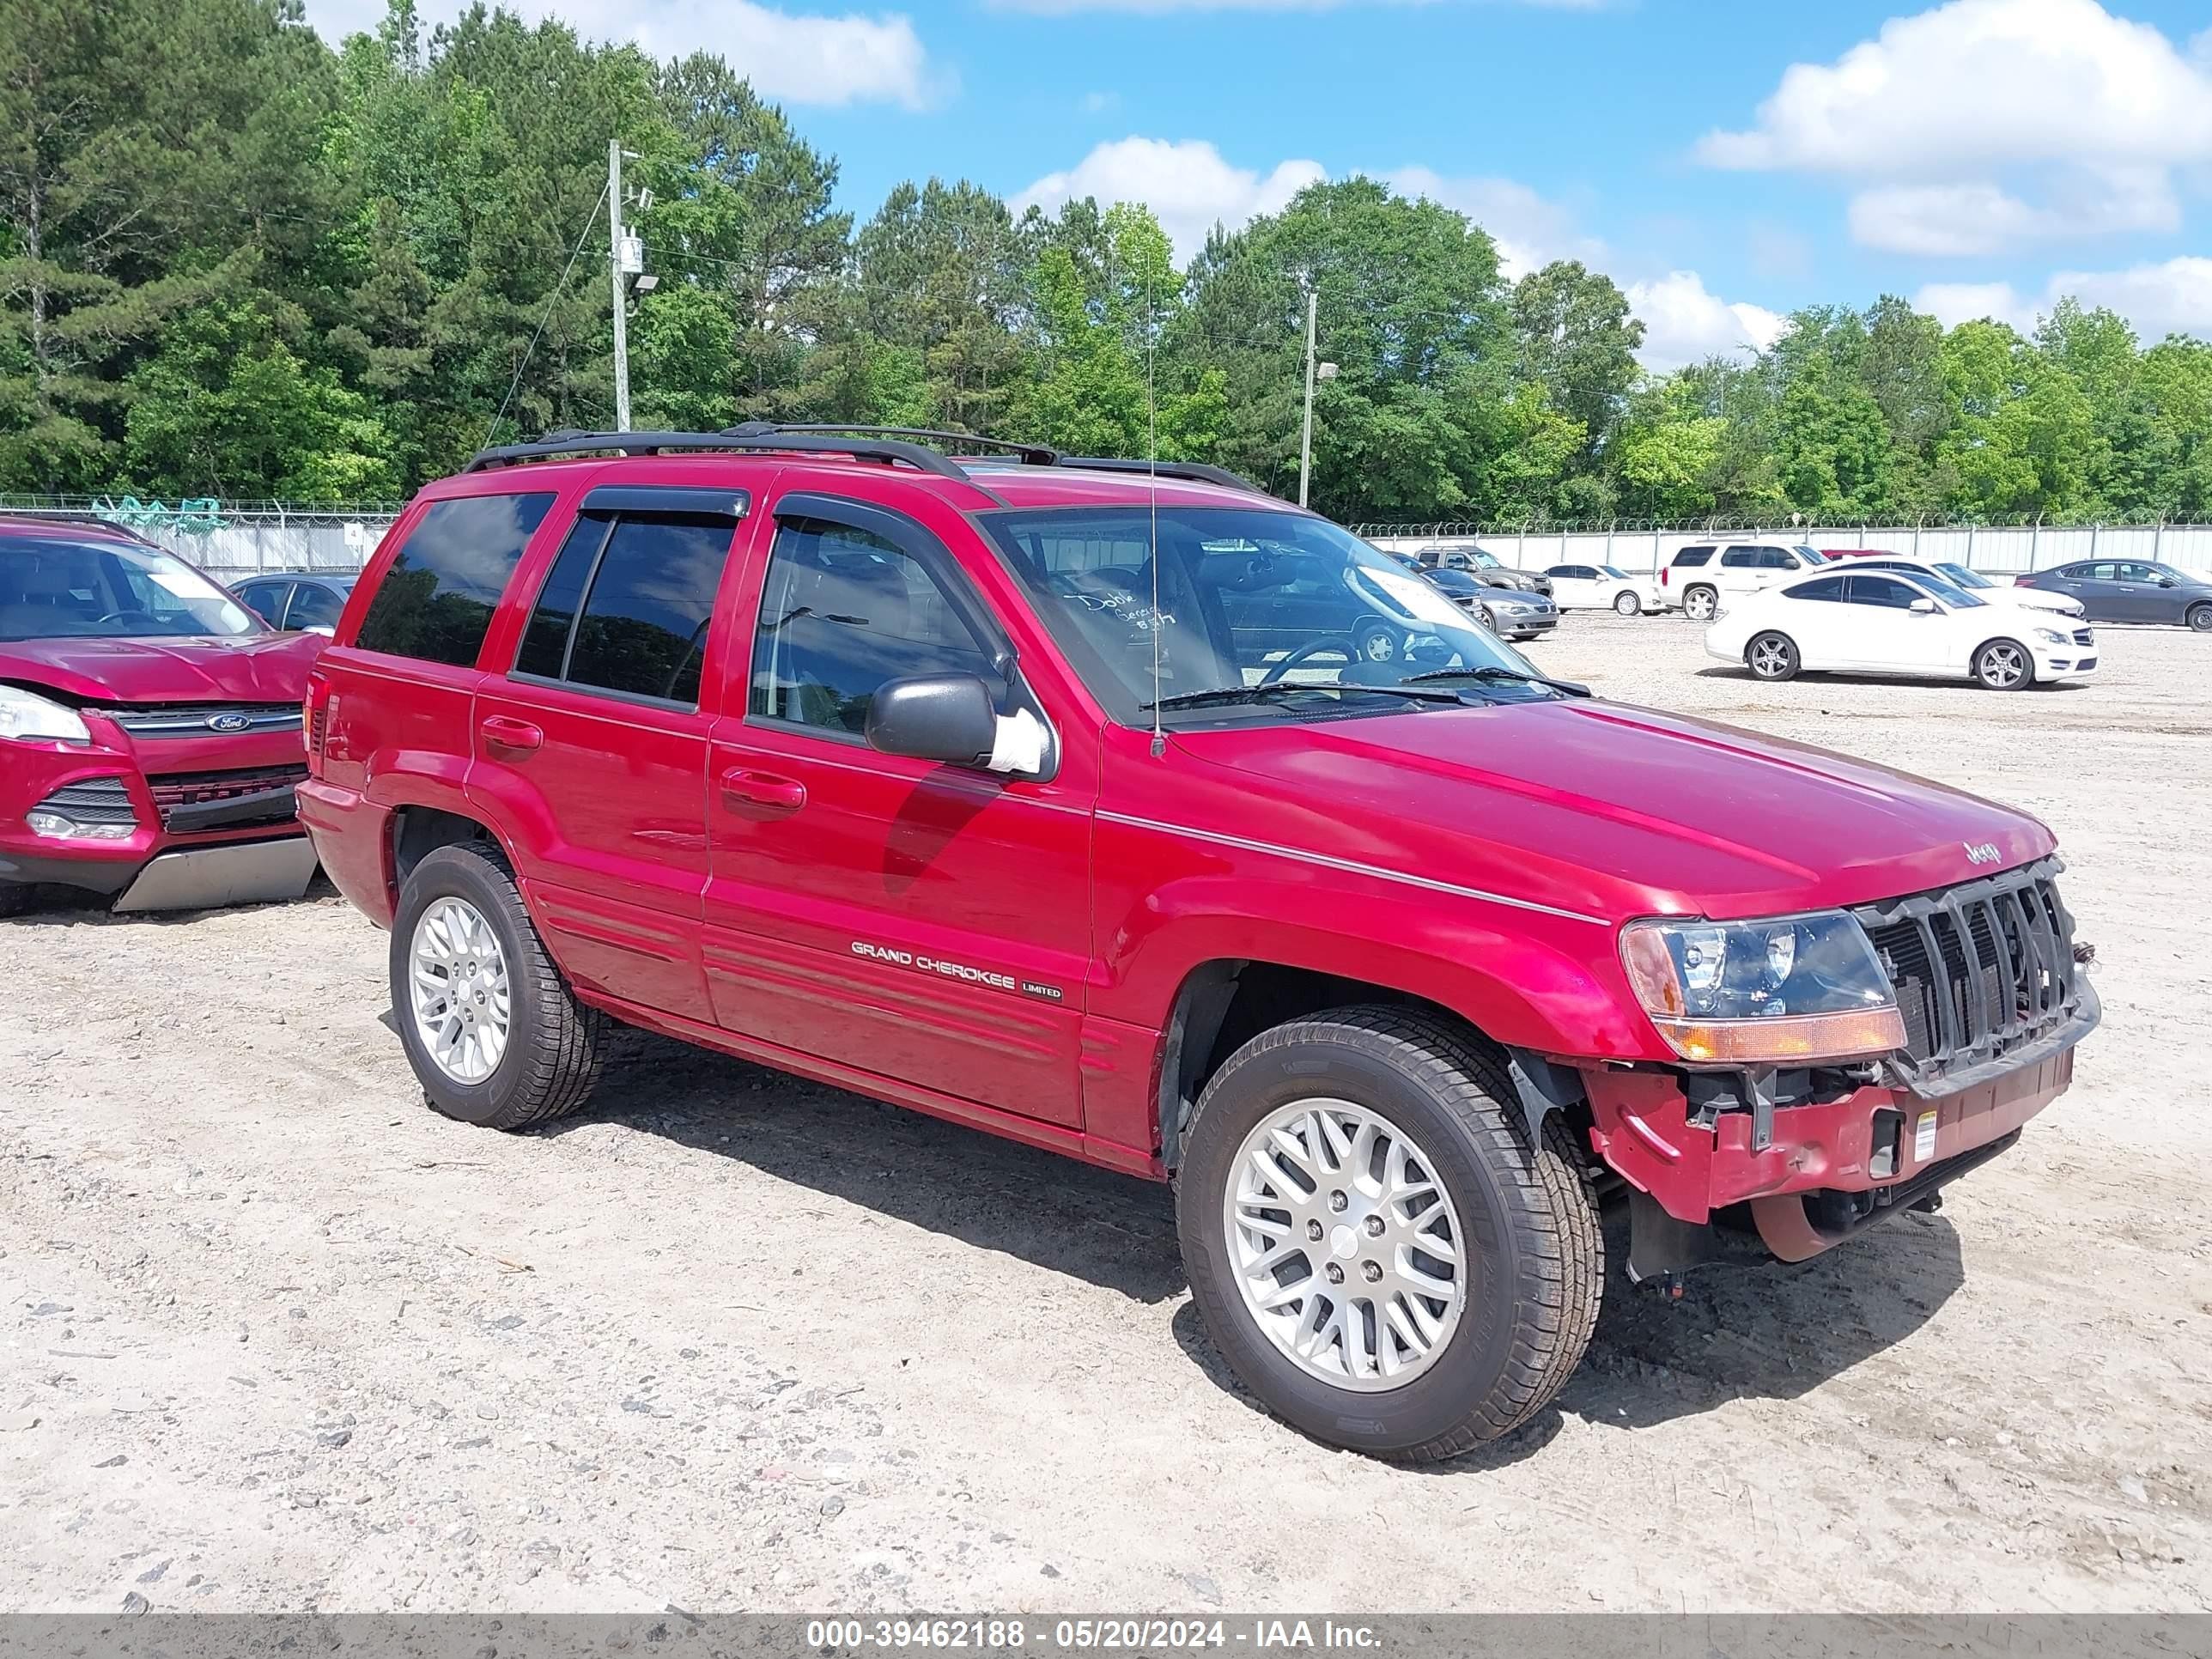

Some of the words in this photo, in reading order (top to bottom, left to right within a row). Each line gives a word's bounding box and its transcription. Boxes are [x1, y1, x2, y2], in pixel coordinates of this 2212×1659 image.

[220, 717, 243, 728] Ford
[1963, 842, 2002, 865] Jeep
[851, 941, 912, 965] GRAND
[916, 957, 1015, 989] CHEROKEE
[1023, 982, 1061, 998] LIMITED
